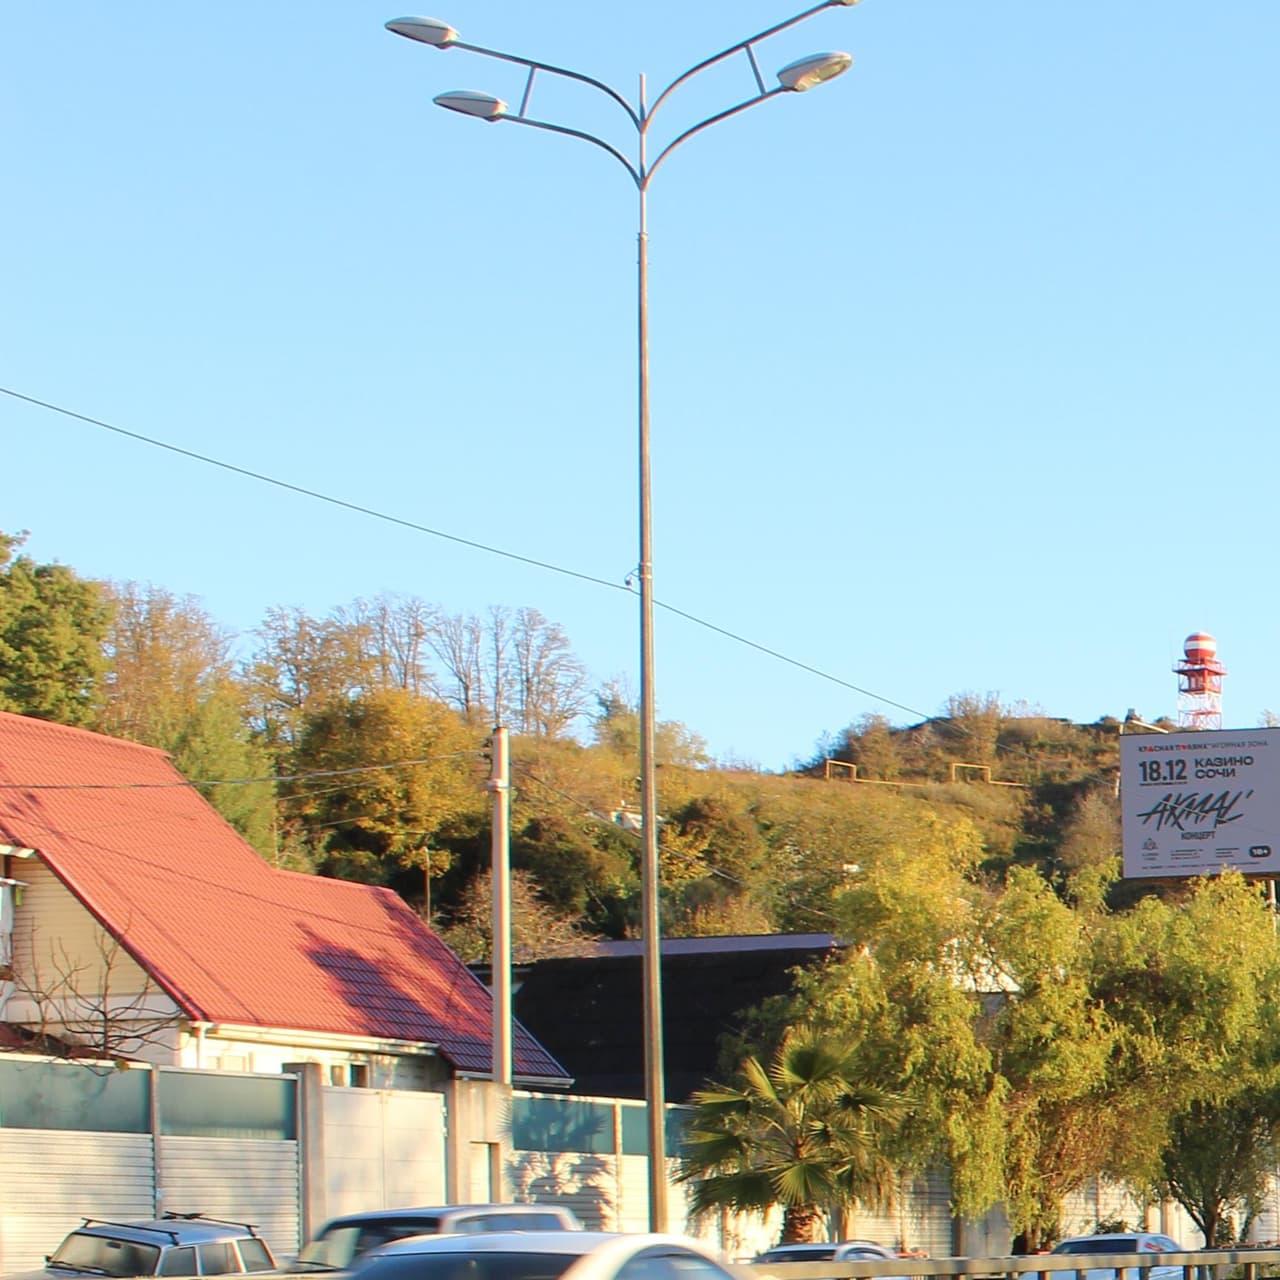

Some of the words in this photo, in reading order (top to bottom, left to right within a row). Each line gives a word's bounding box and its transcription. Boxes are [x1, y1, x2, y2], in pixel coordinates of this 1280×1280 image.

[1194, 756, 1254, 768] КАЗИНО
[1138, 759, 1188, 782] 18.12
[1194, 768, 1236, 779] СОЧИ
[1180, 831, 1216, 840] КОНЦЕРТ
